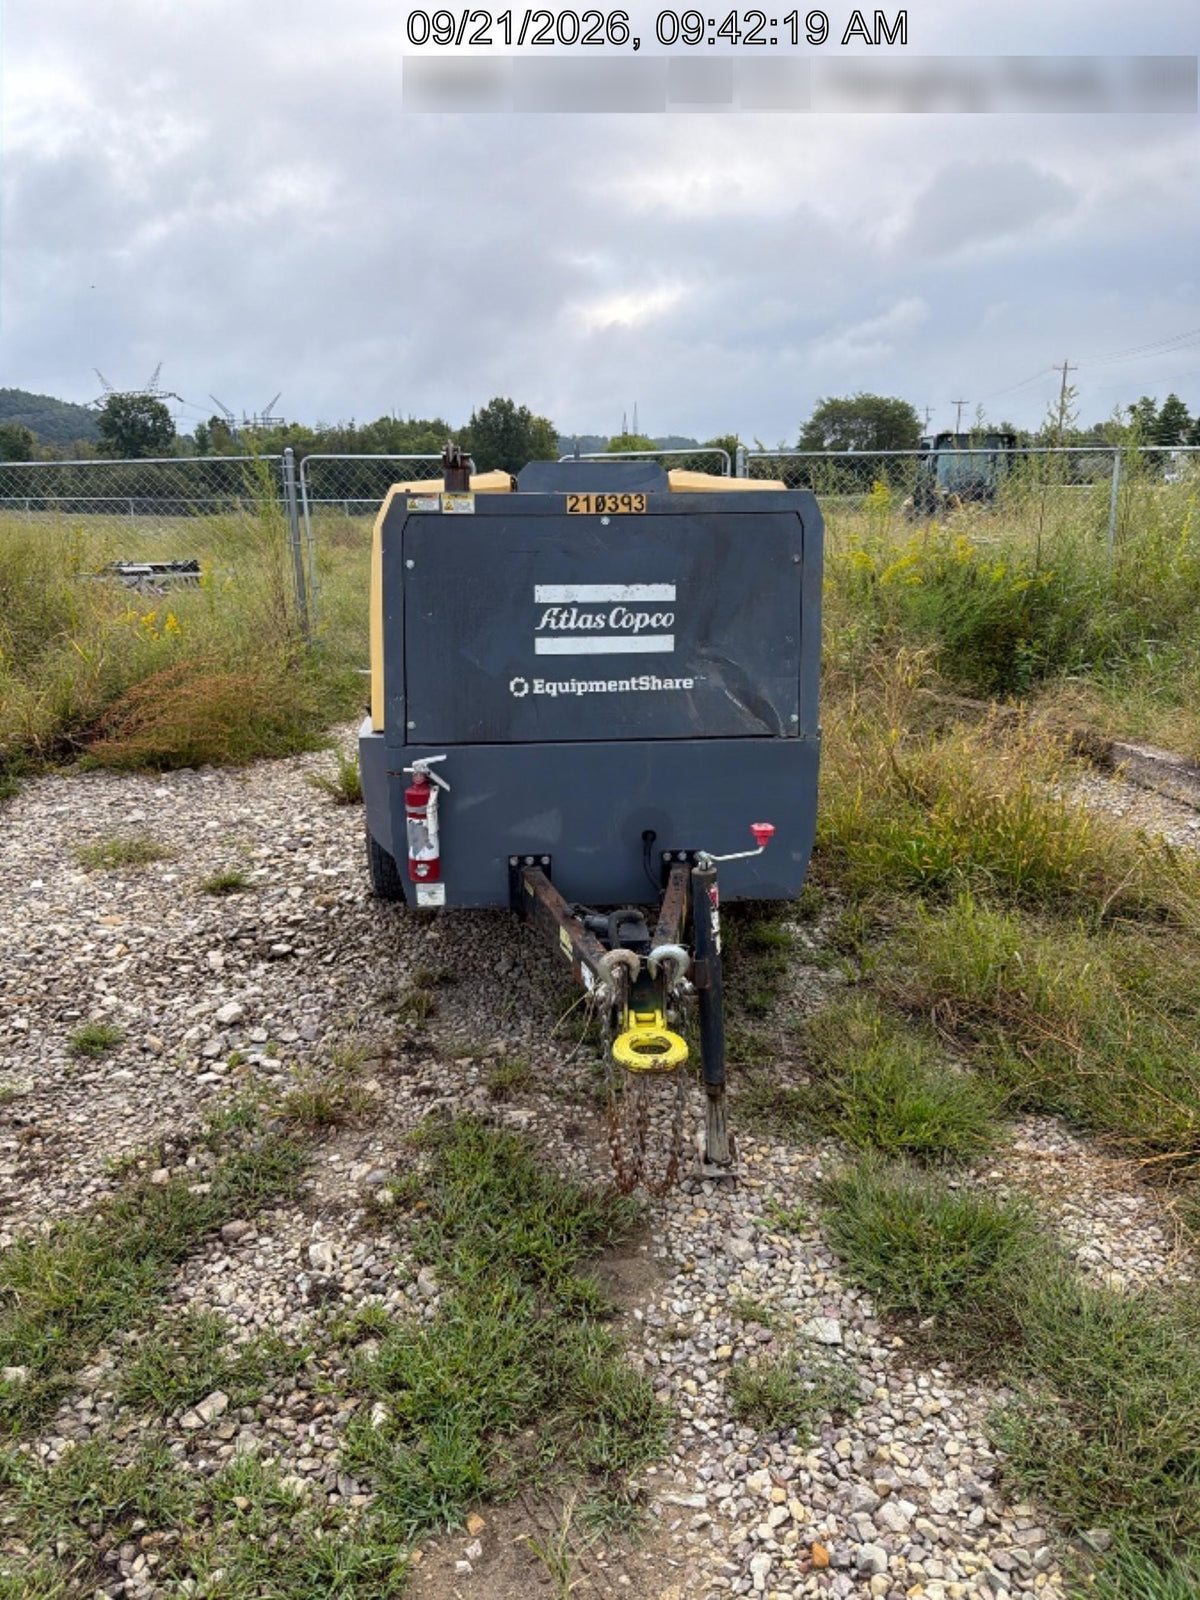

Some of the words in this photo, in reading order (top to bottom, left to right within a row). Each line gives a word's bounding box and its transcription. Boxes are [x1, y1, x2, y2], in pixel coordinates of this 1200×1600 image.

[568, 494, 645, 513] 210393
[535, 607, 606, 630] Atlas
[608, 606, 675, 634] Copco
[532, 675, 694, 698] EquipmentShare
